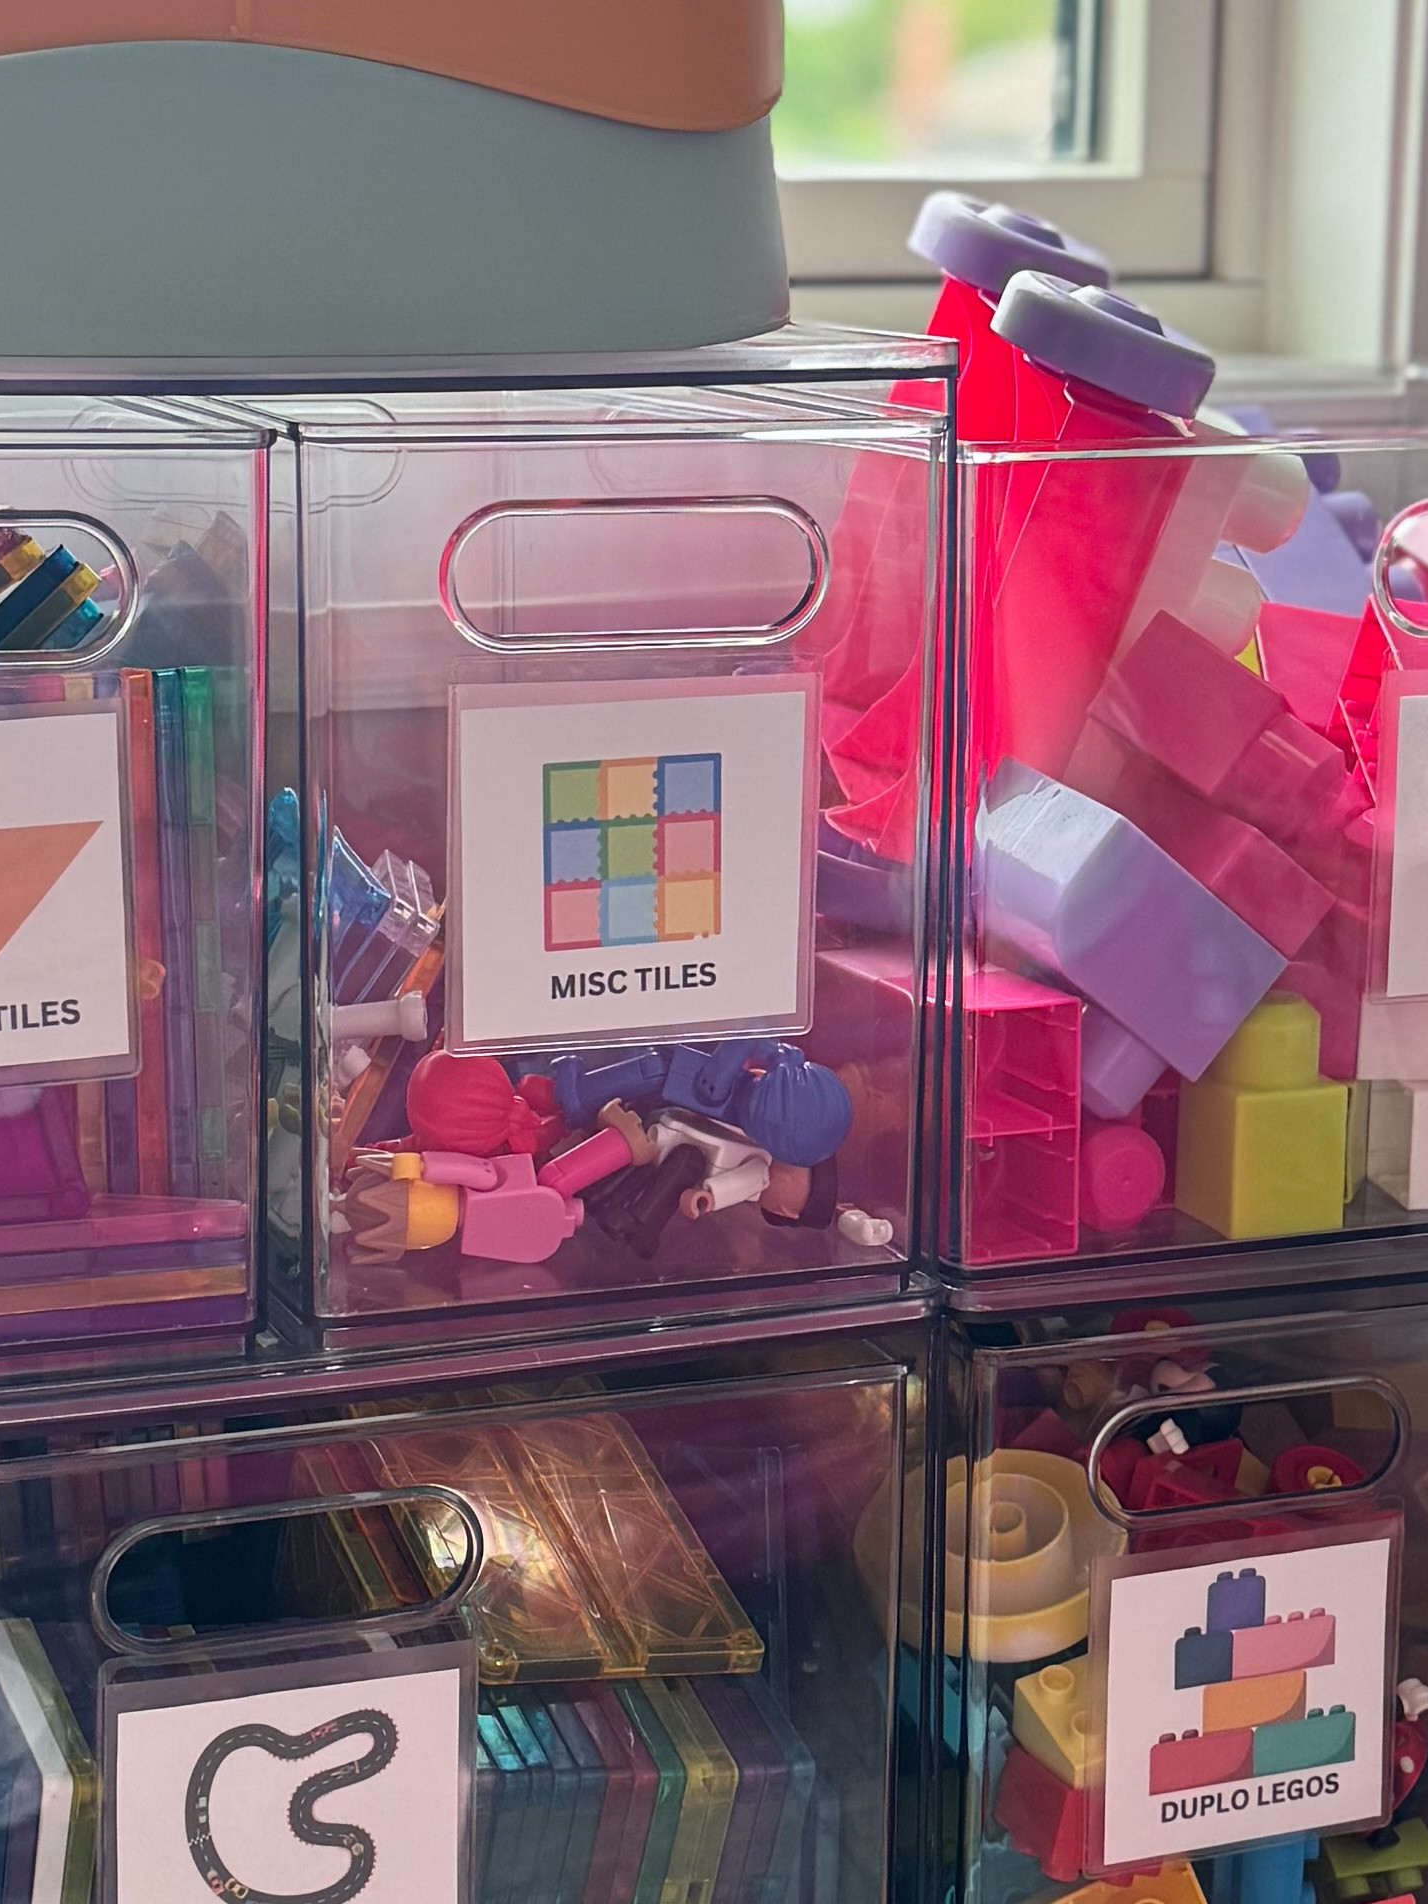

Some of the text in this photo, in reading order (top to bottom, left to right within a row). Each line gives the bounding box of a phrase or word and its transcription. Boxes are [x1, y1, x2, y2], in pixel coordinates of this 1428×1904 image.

[550, 962, 717, 1000] MISC TILES
[1161, 1772, 1340, 1824] DUPLO LEGOS
